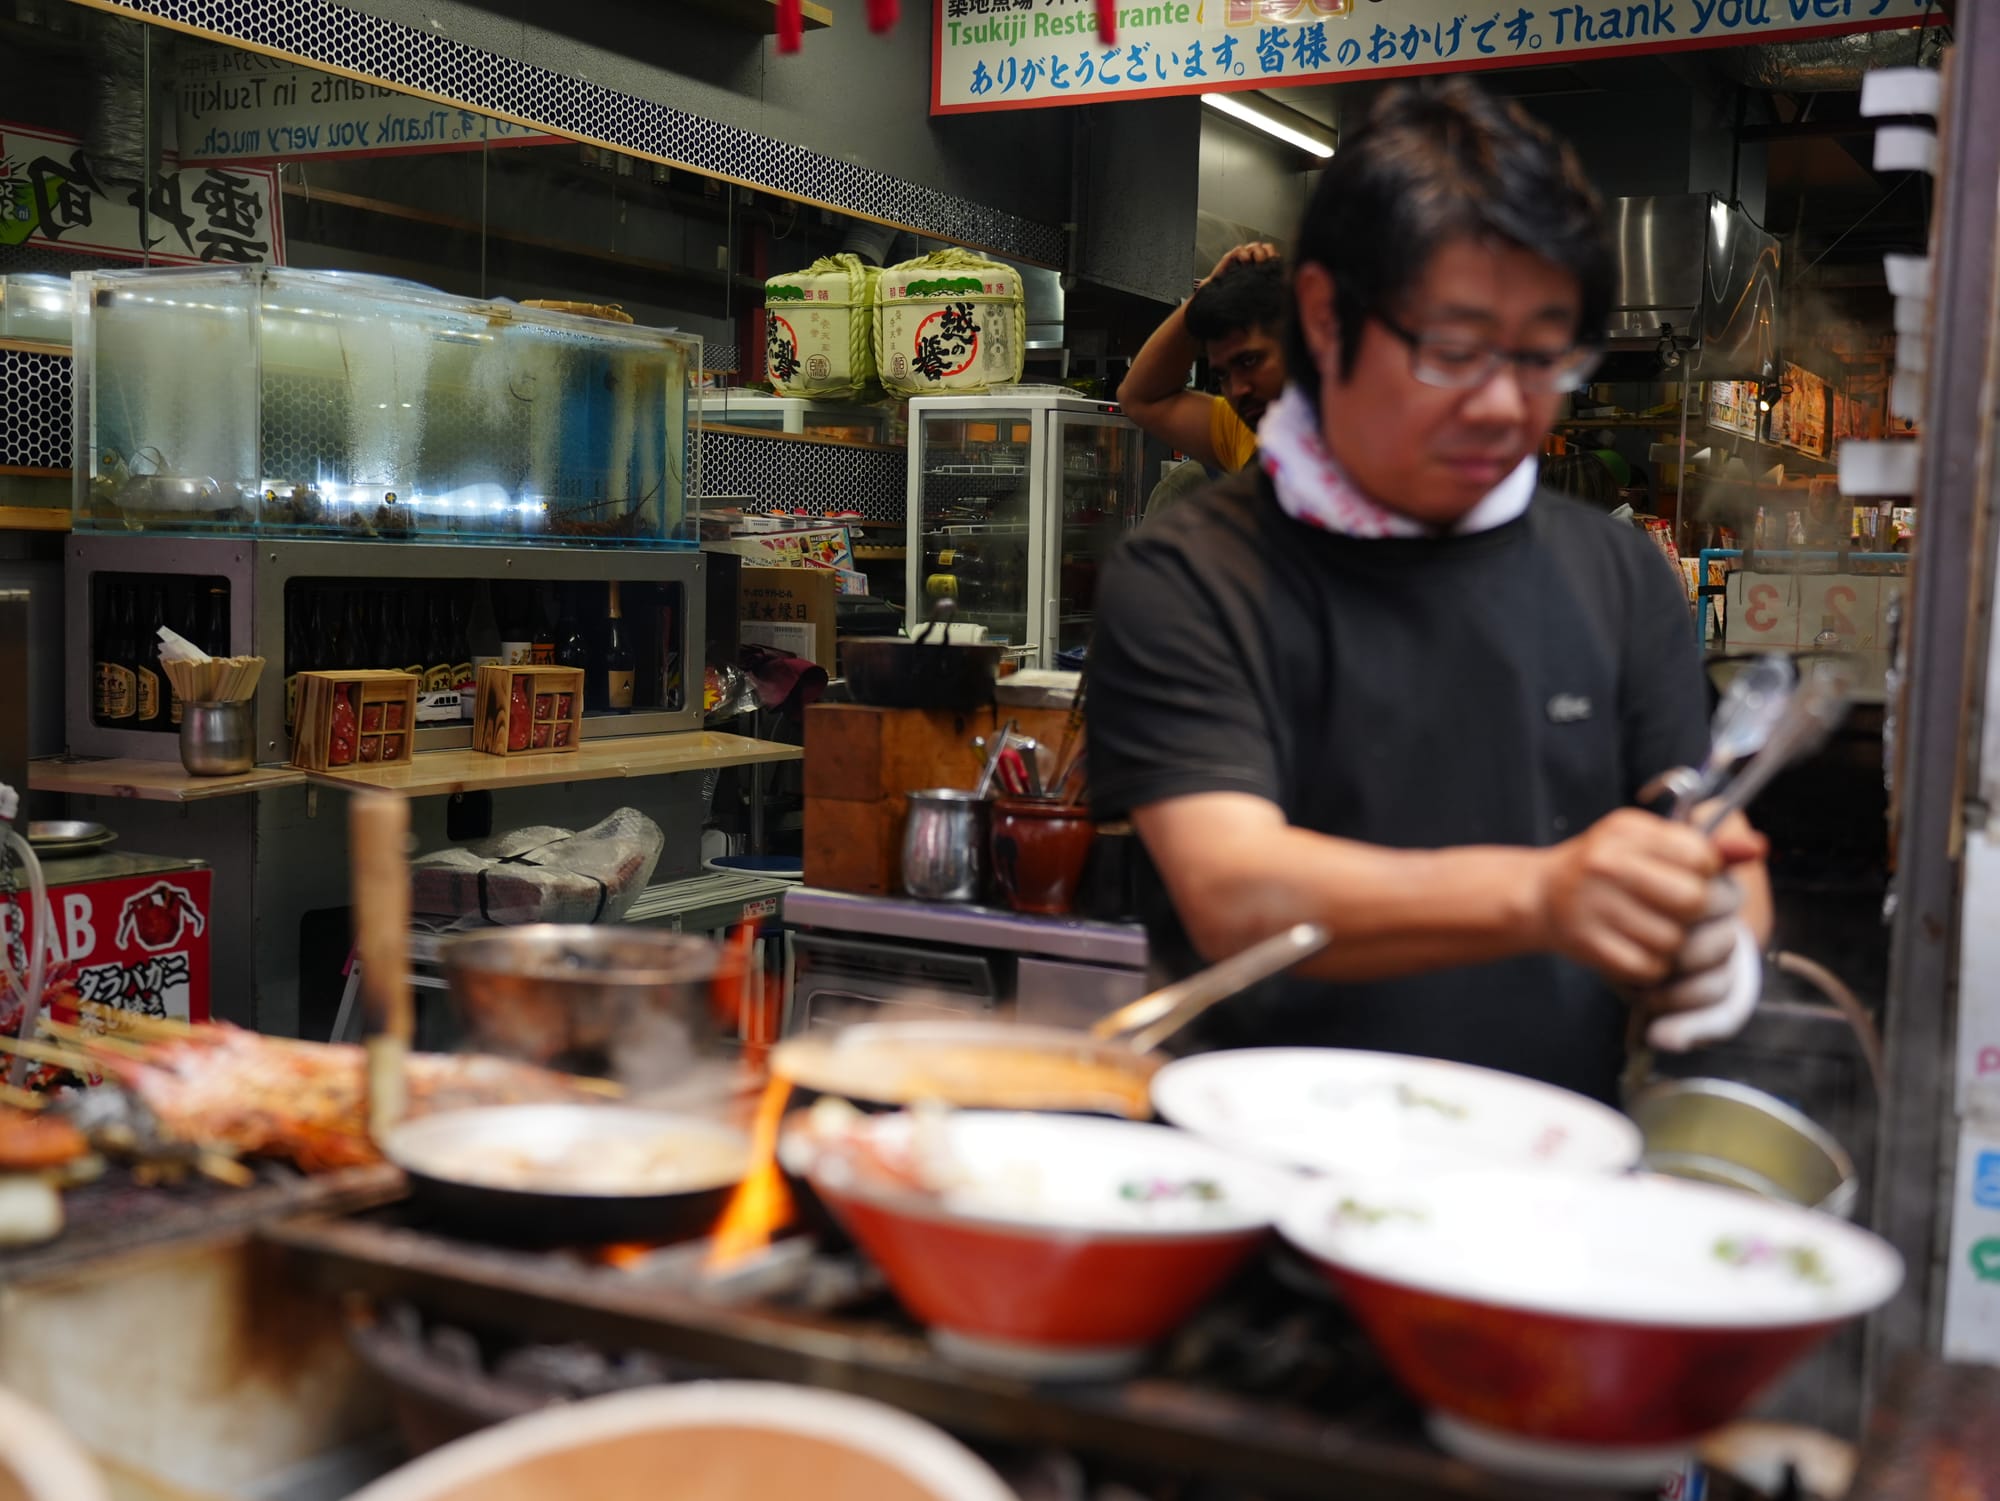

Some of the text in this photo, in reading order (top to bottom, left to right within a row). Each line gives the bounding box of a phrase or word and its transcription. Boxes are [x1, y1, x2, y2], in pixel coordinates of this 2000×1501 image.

[948, 14, 1027, 47] Tsukiji
[1034, 2, 1191, 38] Restarante
[1548, 2, 1677, 44] Thank
[1690, 0, 1771, 34] you
